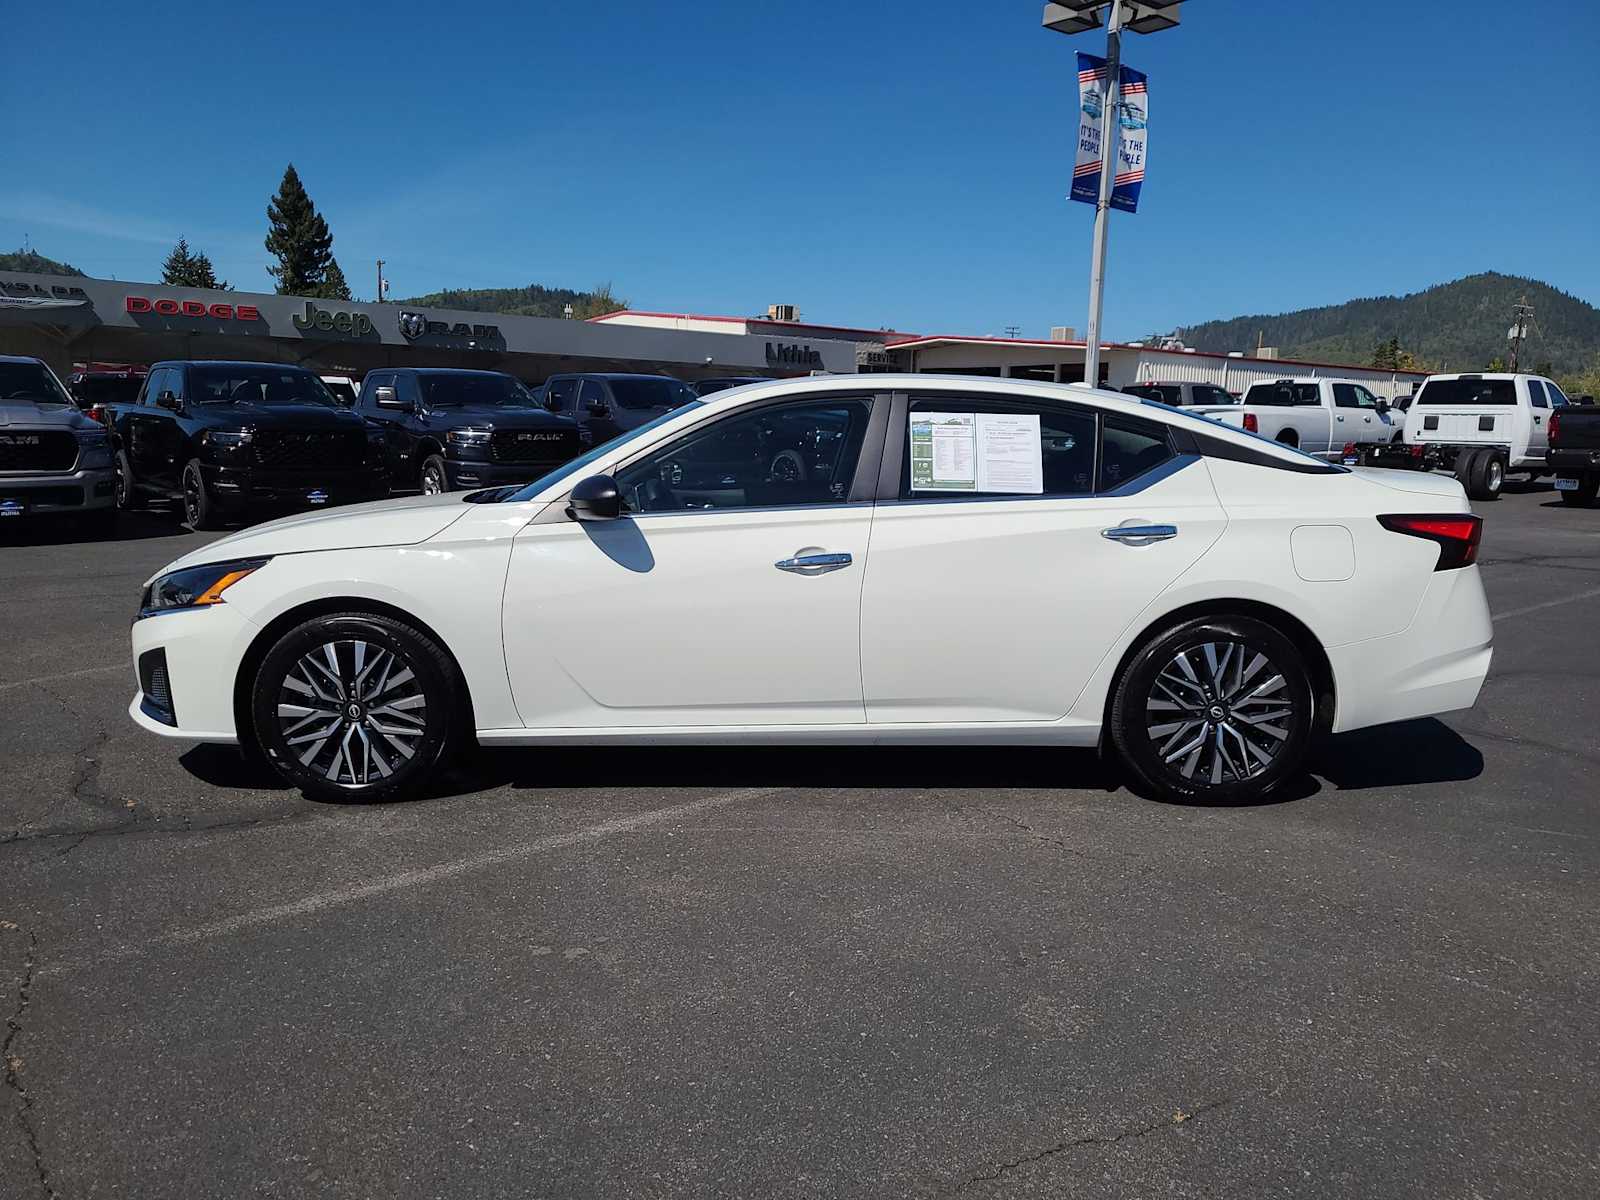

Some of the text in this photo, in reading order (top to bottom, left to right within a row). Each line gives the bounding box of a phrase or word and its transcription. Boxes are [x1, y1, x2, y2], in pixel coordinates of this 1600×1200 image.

[1081, 125, 1091, 138] IT'S
[1080, 139, 1099, 154] PEOPLE
[1130, 140, 1143, 151] THE
[0, 280, 83, 296] YSLER
[126, 296, 257, 321] DODGE
[292, 301, 372, 337] Jeep
[428, 321, 499, 338] RAM
[867, 352, 898, 363] SERVICE
[0, 436, 39, 445] AM
[517, 433, 562, 441] RAM
